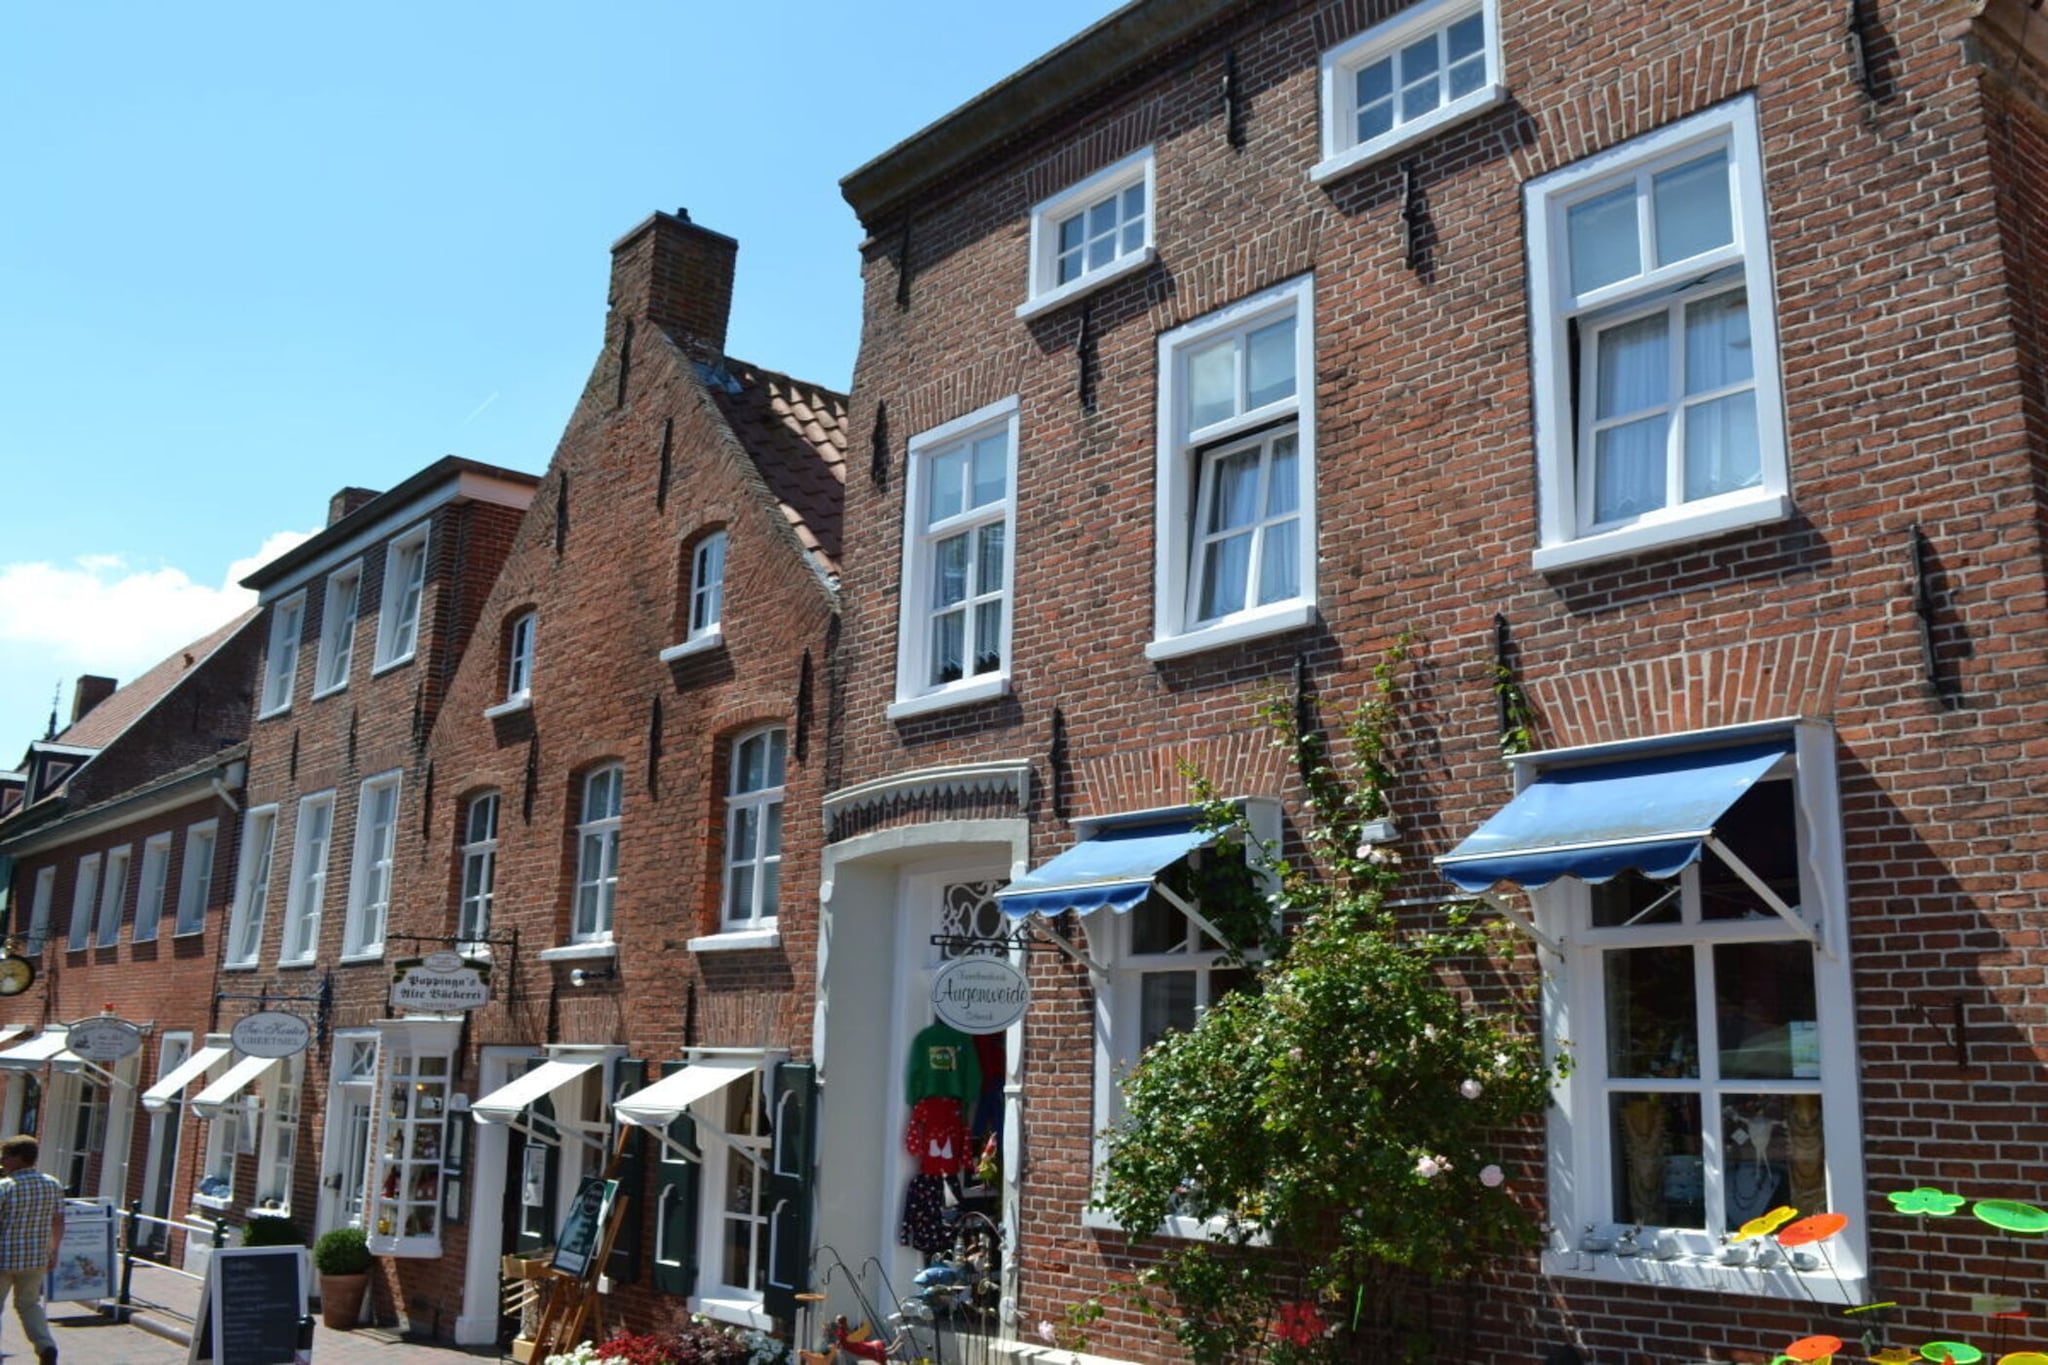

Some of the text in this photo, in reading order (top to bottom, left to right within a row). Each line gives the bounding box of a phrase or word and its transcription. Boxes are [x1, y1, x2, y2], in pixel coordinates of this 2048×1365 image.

[400, 987, 482, 999] Alte Bäckerei
[932, 977, 1028, 1009] Augenweide
